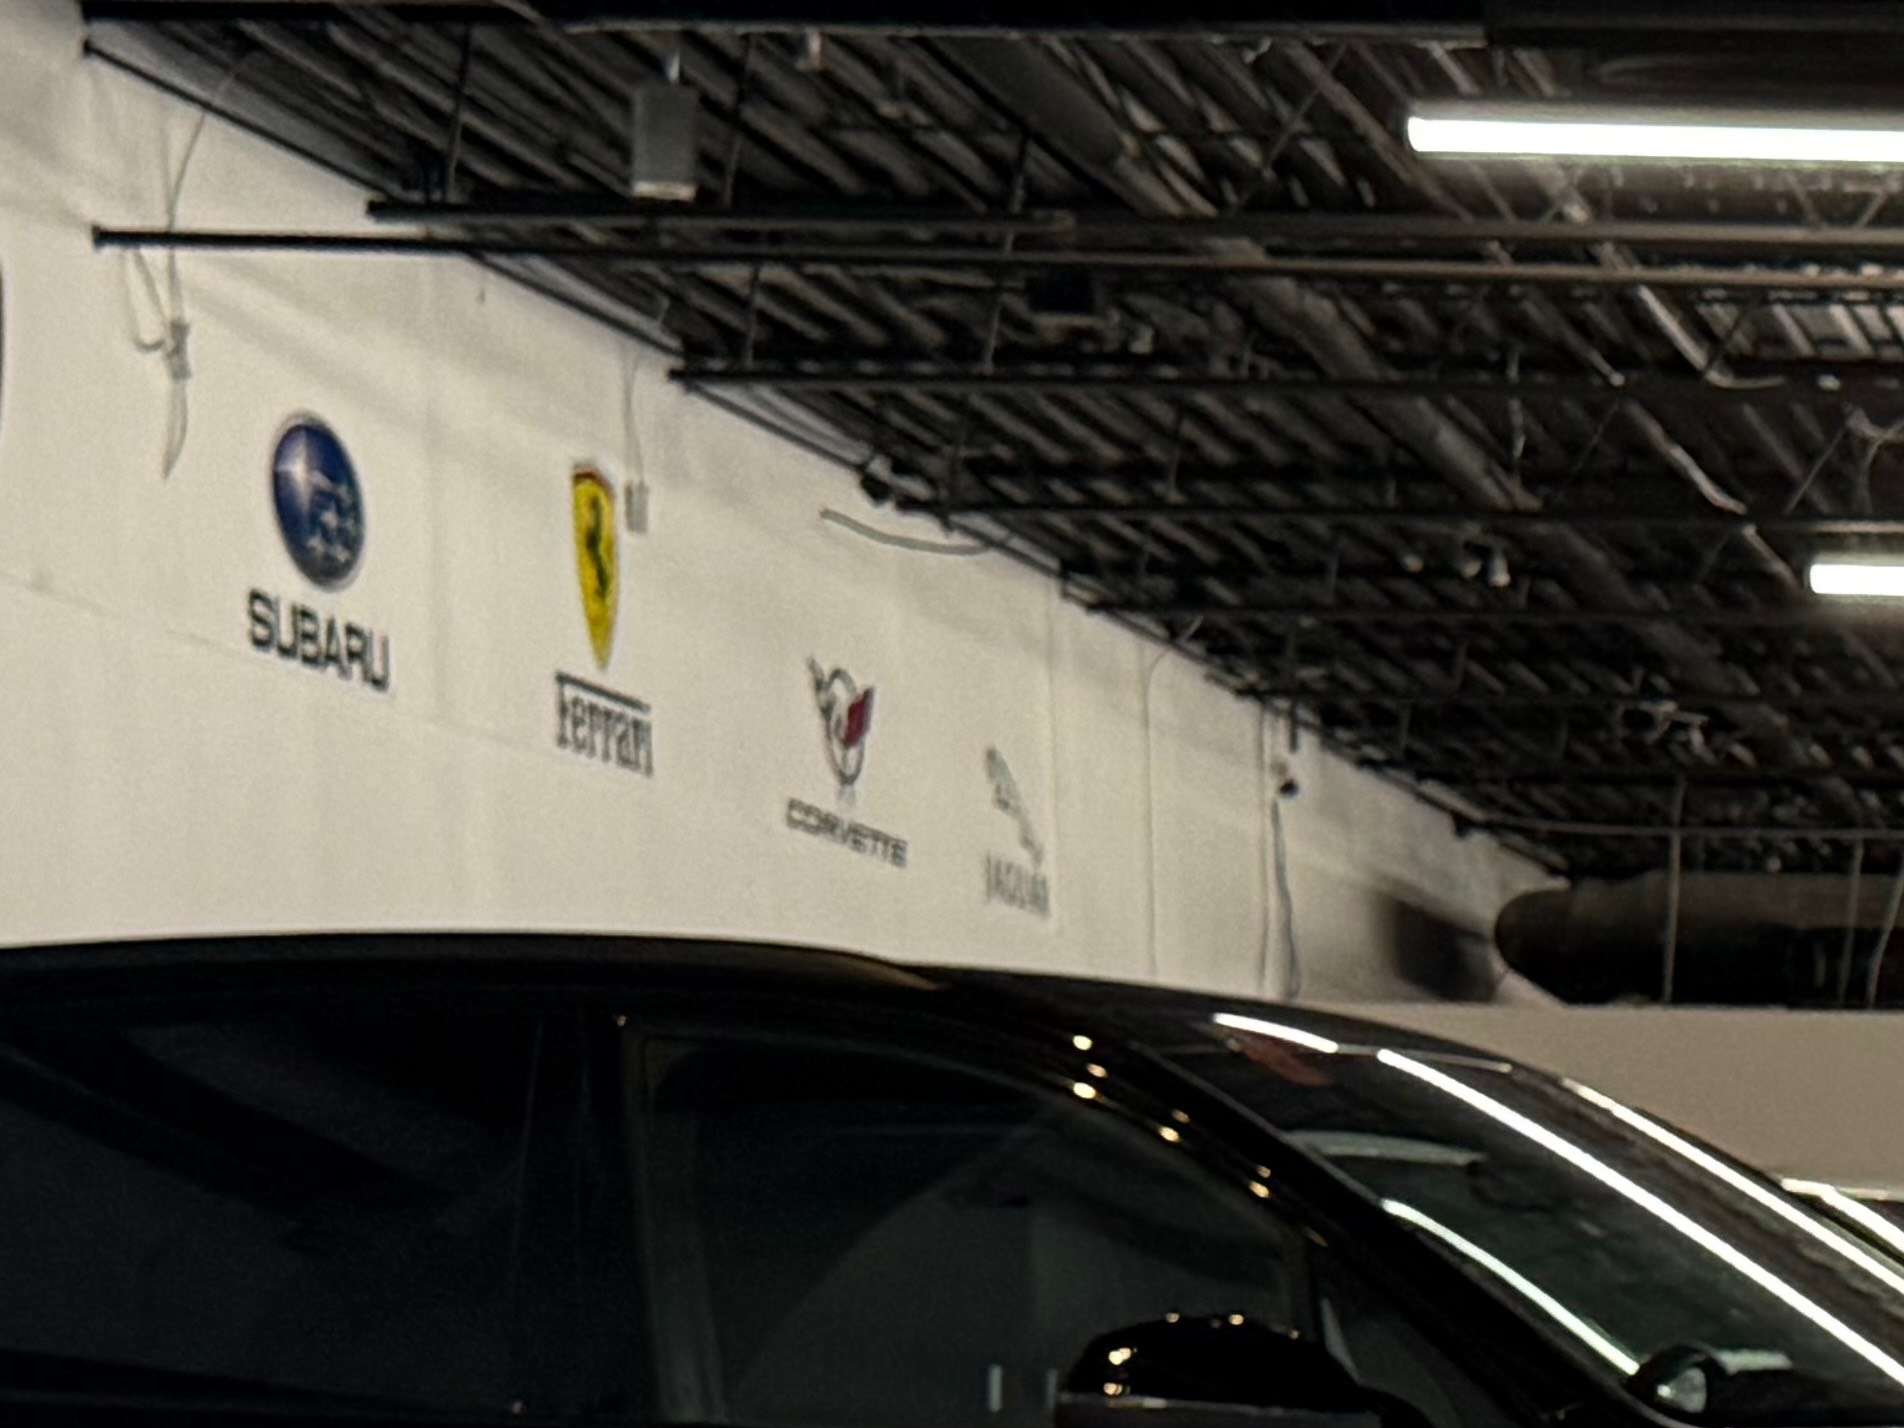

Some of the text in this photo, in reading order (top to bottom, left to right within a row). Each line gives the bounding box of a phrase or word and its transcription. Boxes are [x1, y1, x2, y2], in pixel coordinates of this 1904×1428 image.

[246, 588, 392, 693] SUBARU
[554, 671, 654, 778] Ferrari
[786, 797, 909, 868] CORVETTE
